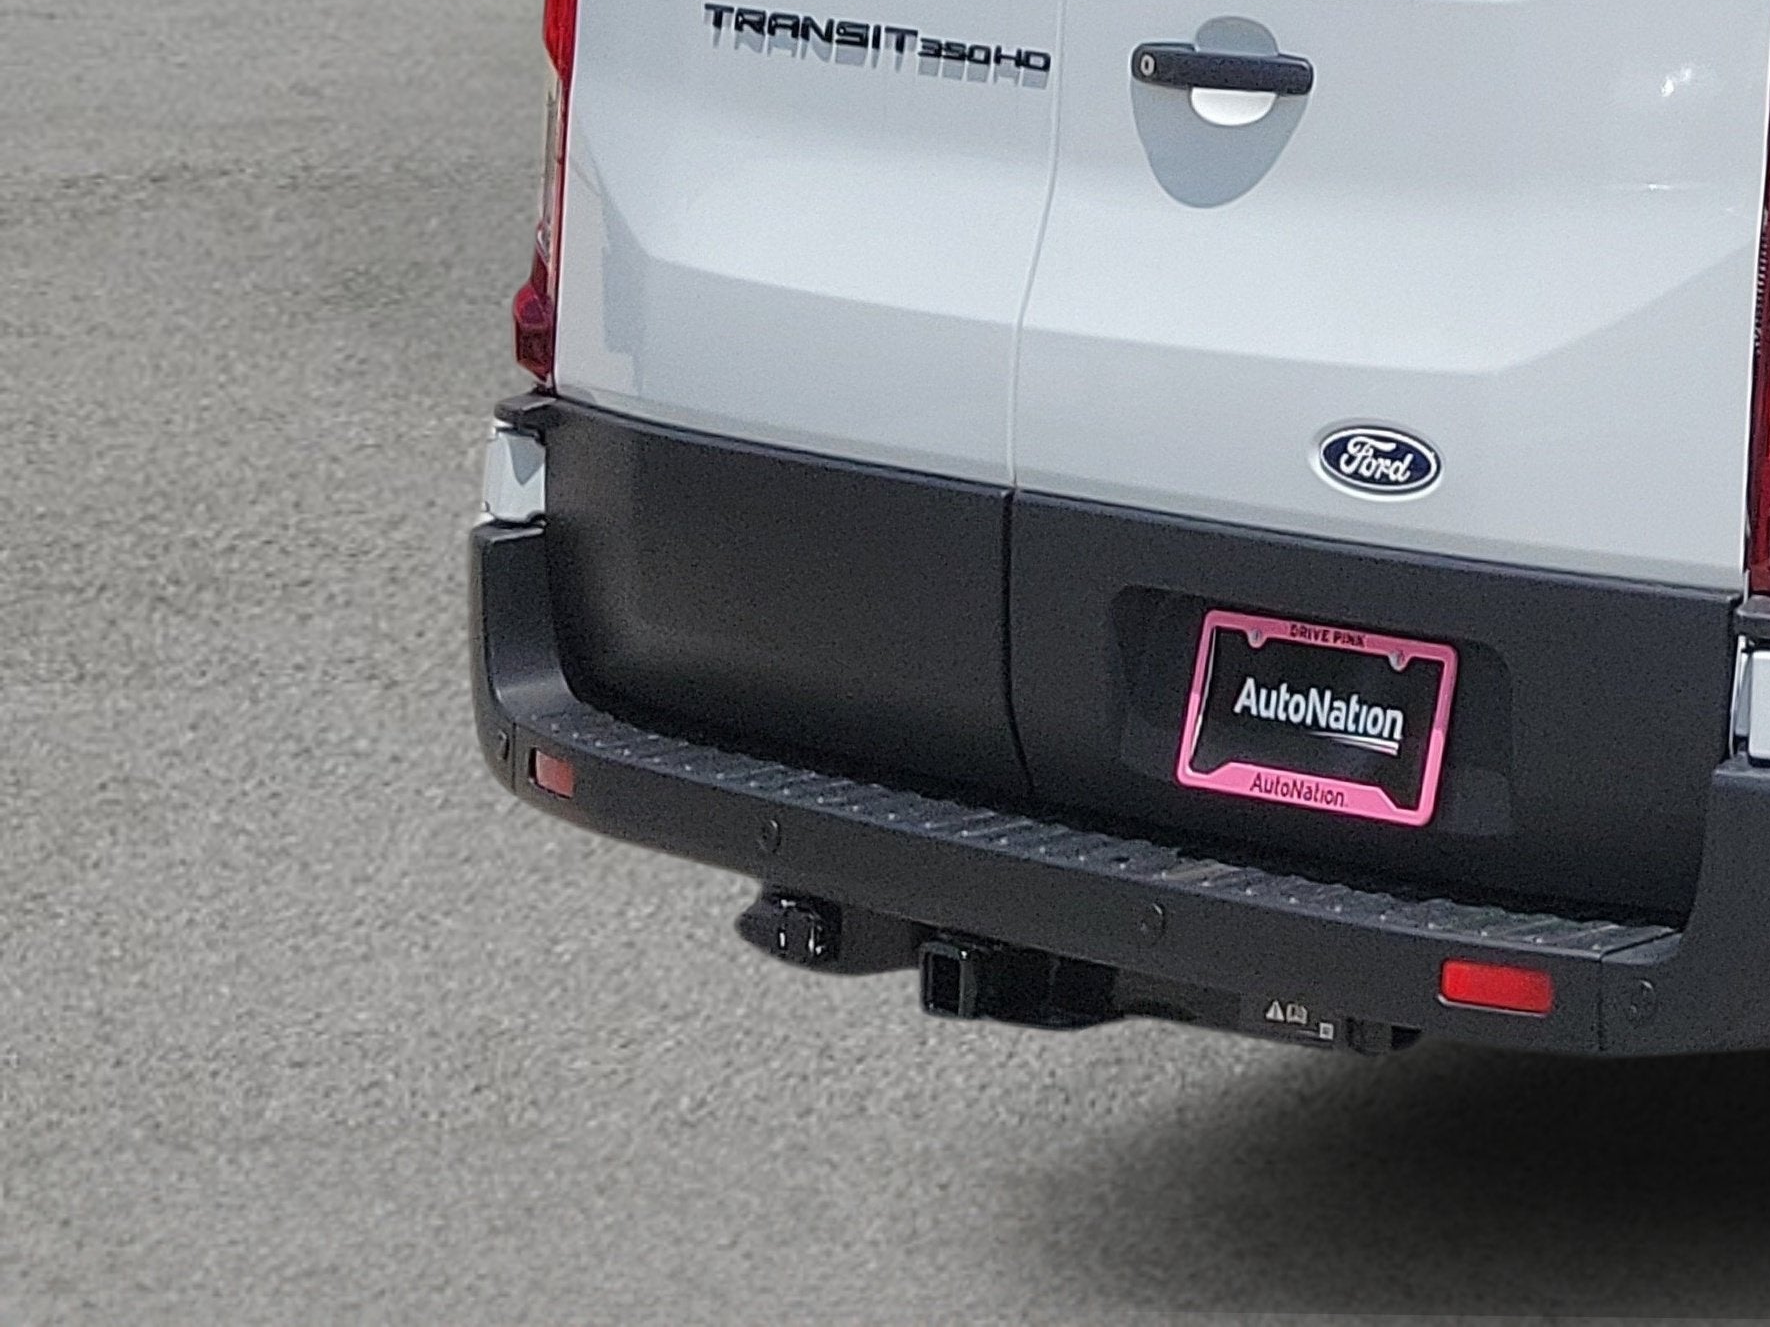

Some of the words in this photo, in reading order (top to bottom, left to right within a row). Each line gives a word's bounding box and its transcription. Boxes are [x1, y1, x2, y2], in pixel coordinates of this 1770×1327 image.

[704, 2, 919, 54] TRANSIT
[1339, 436, 1414, 482] Ford
[1290, 624, 1329, 642] DRIVE
[1234, 676, 1405, 740] AutoNation
[1250, 771, 1345, 807] AutoNation
